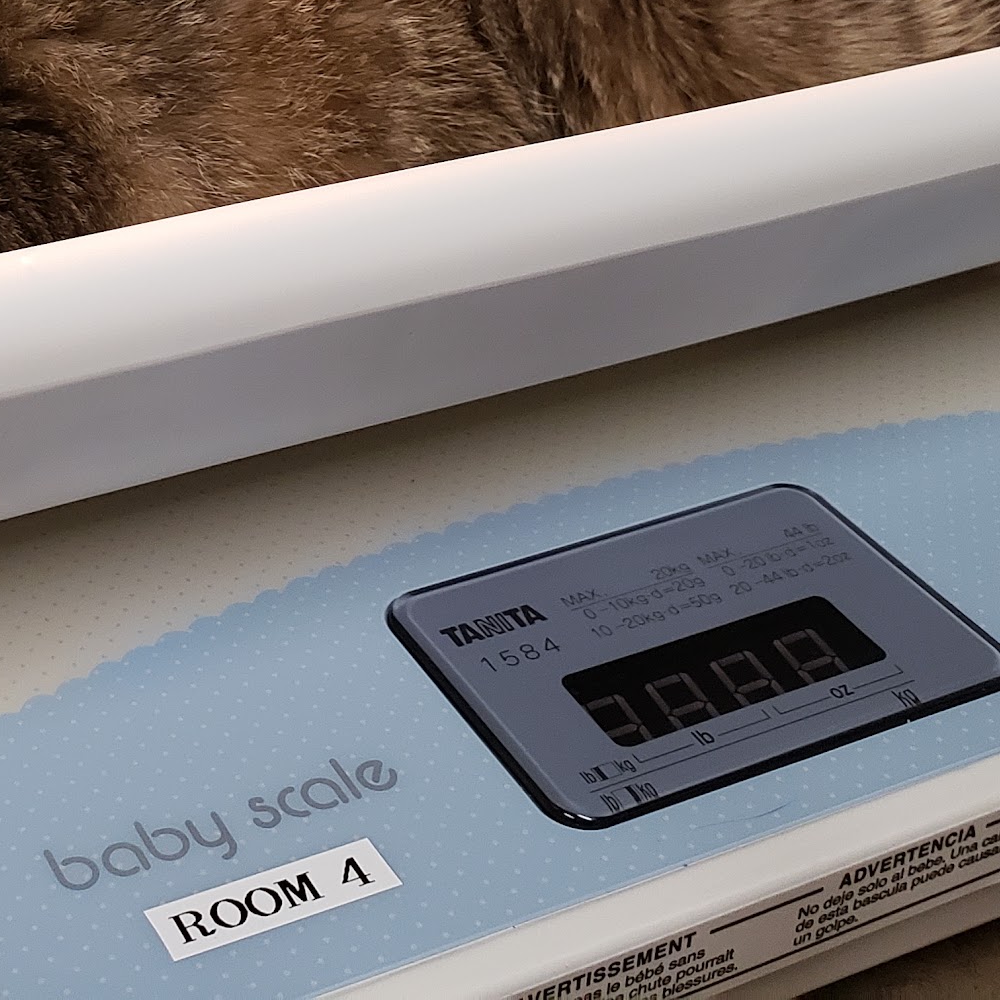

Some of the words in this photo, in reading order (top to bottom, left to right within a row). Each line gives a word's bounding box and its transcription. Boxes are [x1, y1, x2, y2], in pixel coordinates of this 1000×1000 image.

[438, 604, 548, 648] TANITA
[480, 636, 560, 672] 1584
[829, 684, 855, 699] oz
[690, 729, 716, 746] lb
[579, 769, 598, 785] lb
[613, 759, 638, 774] kg
[43, 811, 238, 891] baby
[248, 758, 398, 829] scale
[797, 903, 820, 920] No
[822, 890, 855, 906] deje
[857, 877, 888, 896] solo
[891, 867, 906, 883] al
[950, 841, 978, 860] Una
[838, 824, 976, 890] ADVERTENCIA
[168, 871, 325, 944] ROOM
[341, 856, 376, 888] 4
[795, 918, 815, 933] de
[818, 905, 849, 924] esta
[910, 863, 955, 891] puede
[793, 932, 812, 947] un
[815, 915, 859, 940] golpe.
[518, 931, 697, 1000] VERTISSEMENT
[606, 982, 621, 996] le
[624, 961, 665, 988] bébé
[668, 948, 706, 970] sans
[628, 974, 672, 999] chute
[675, 948, 735, 983] pourrait
[662, 962, 738, 999] blessures.
